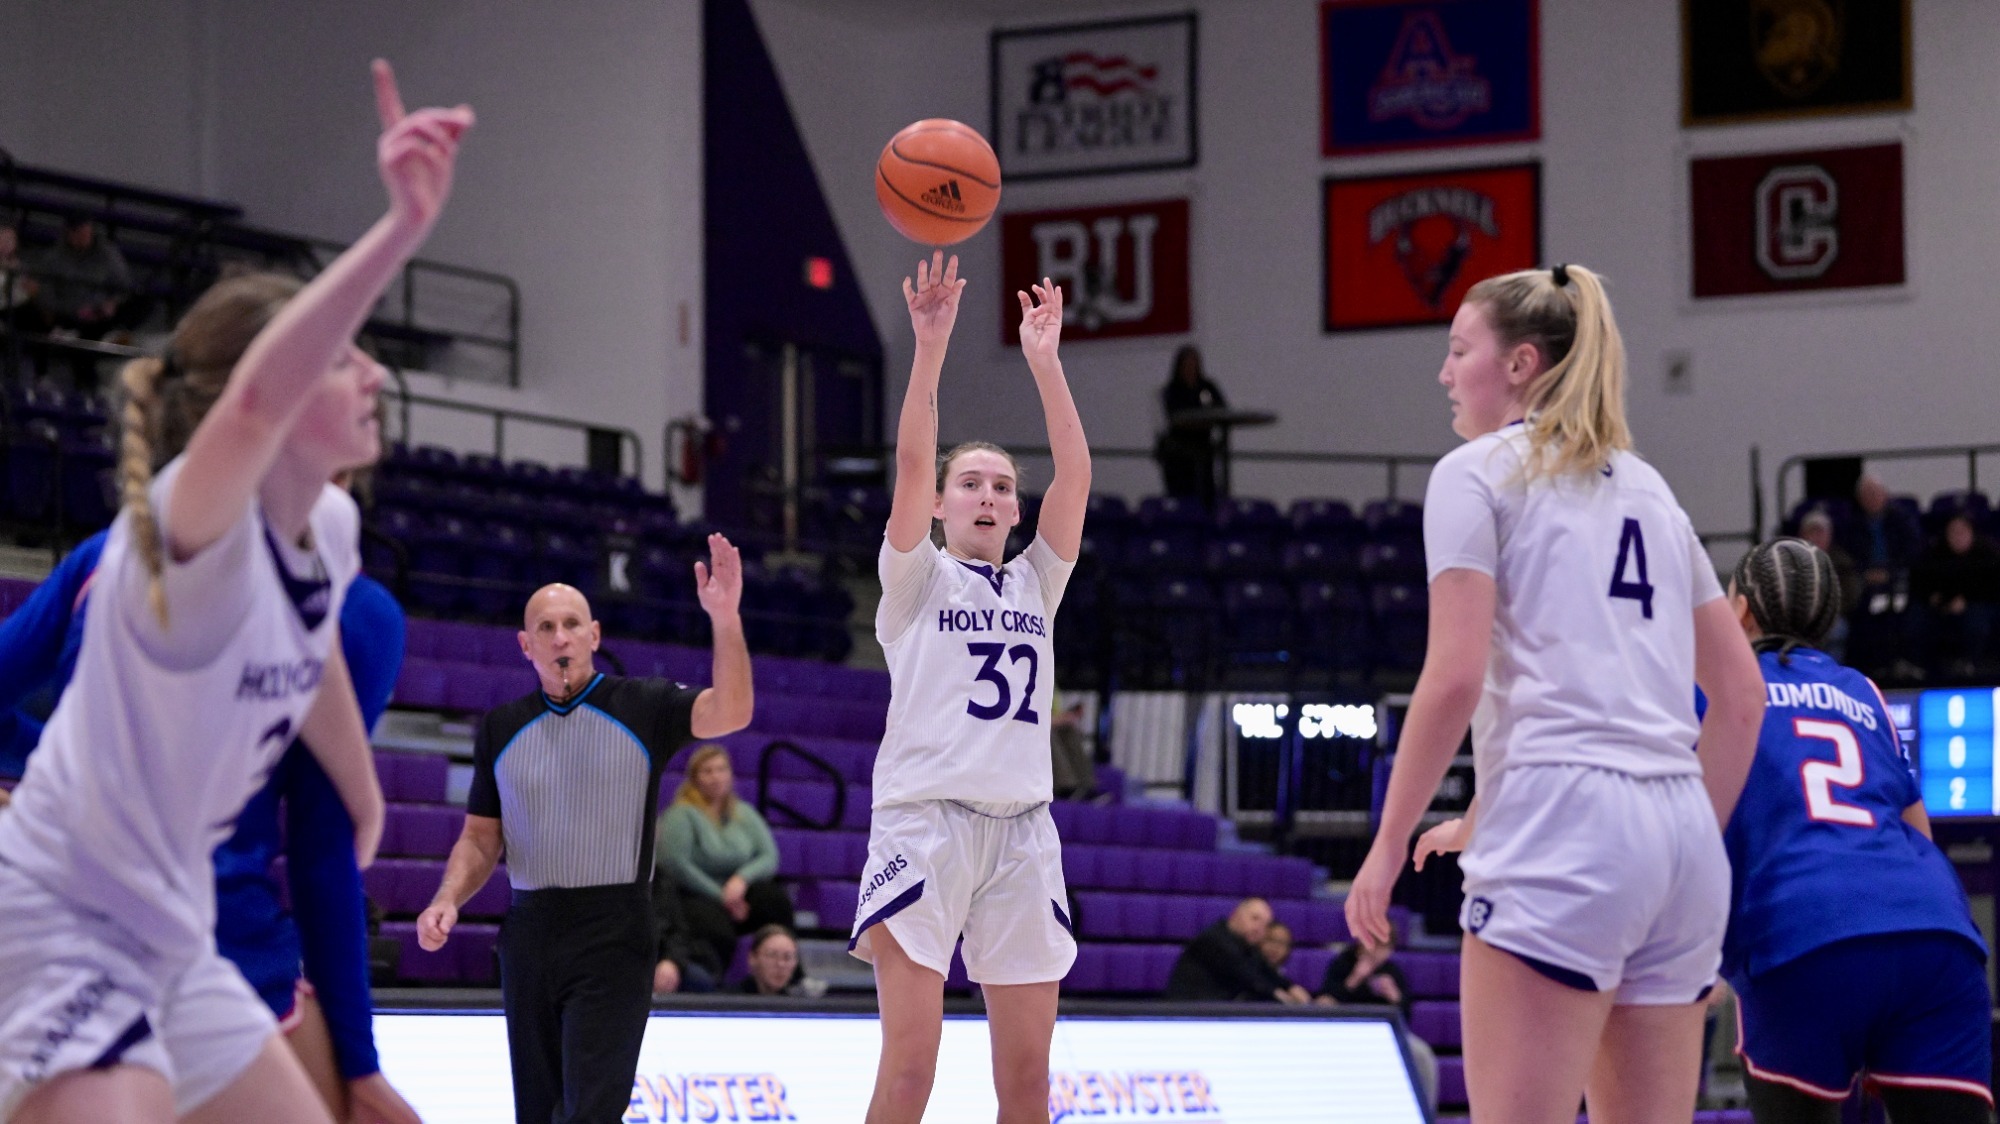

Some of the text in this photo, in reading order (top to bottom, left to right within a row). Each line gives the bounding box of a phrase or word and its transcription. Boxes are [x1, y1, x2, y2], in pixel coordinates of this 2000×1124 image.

[921, 192, 965, 214] adidas
[1756, 165, 1837, 280] C
[1032, 214, 1158, 327] BU
[1609, 517, 1654, 620] 4
[939, 609, 994, 632] HOLY
[966, 642, 1038, 725] 32
[1765, 682, 1878, 731] DMONDS
[1793, 717, 1877, 829] 2
[1949, 776, 1966, 810] 2
[855, 854, 907, 919] USADERS
